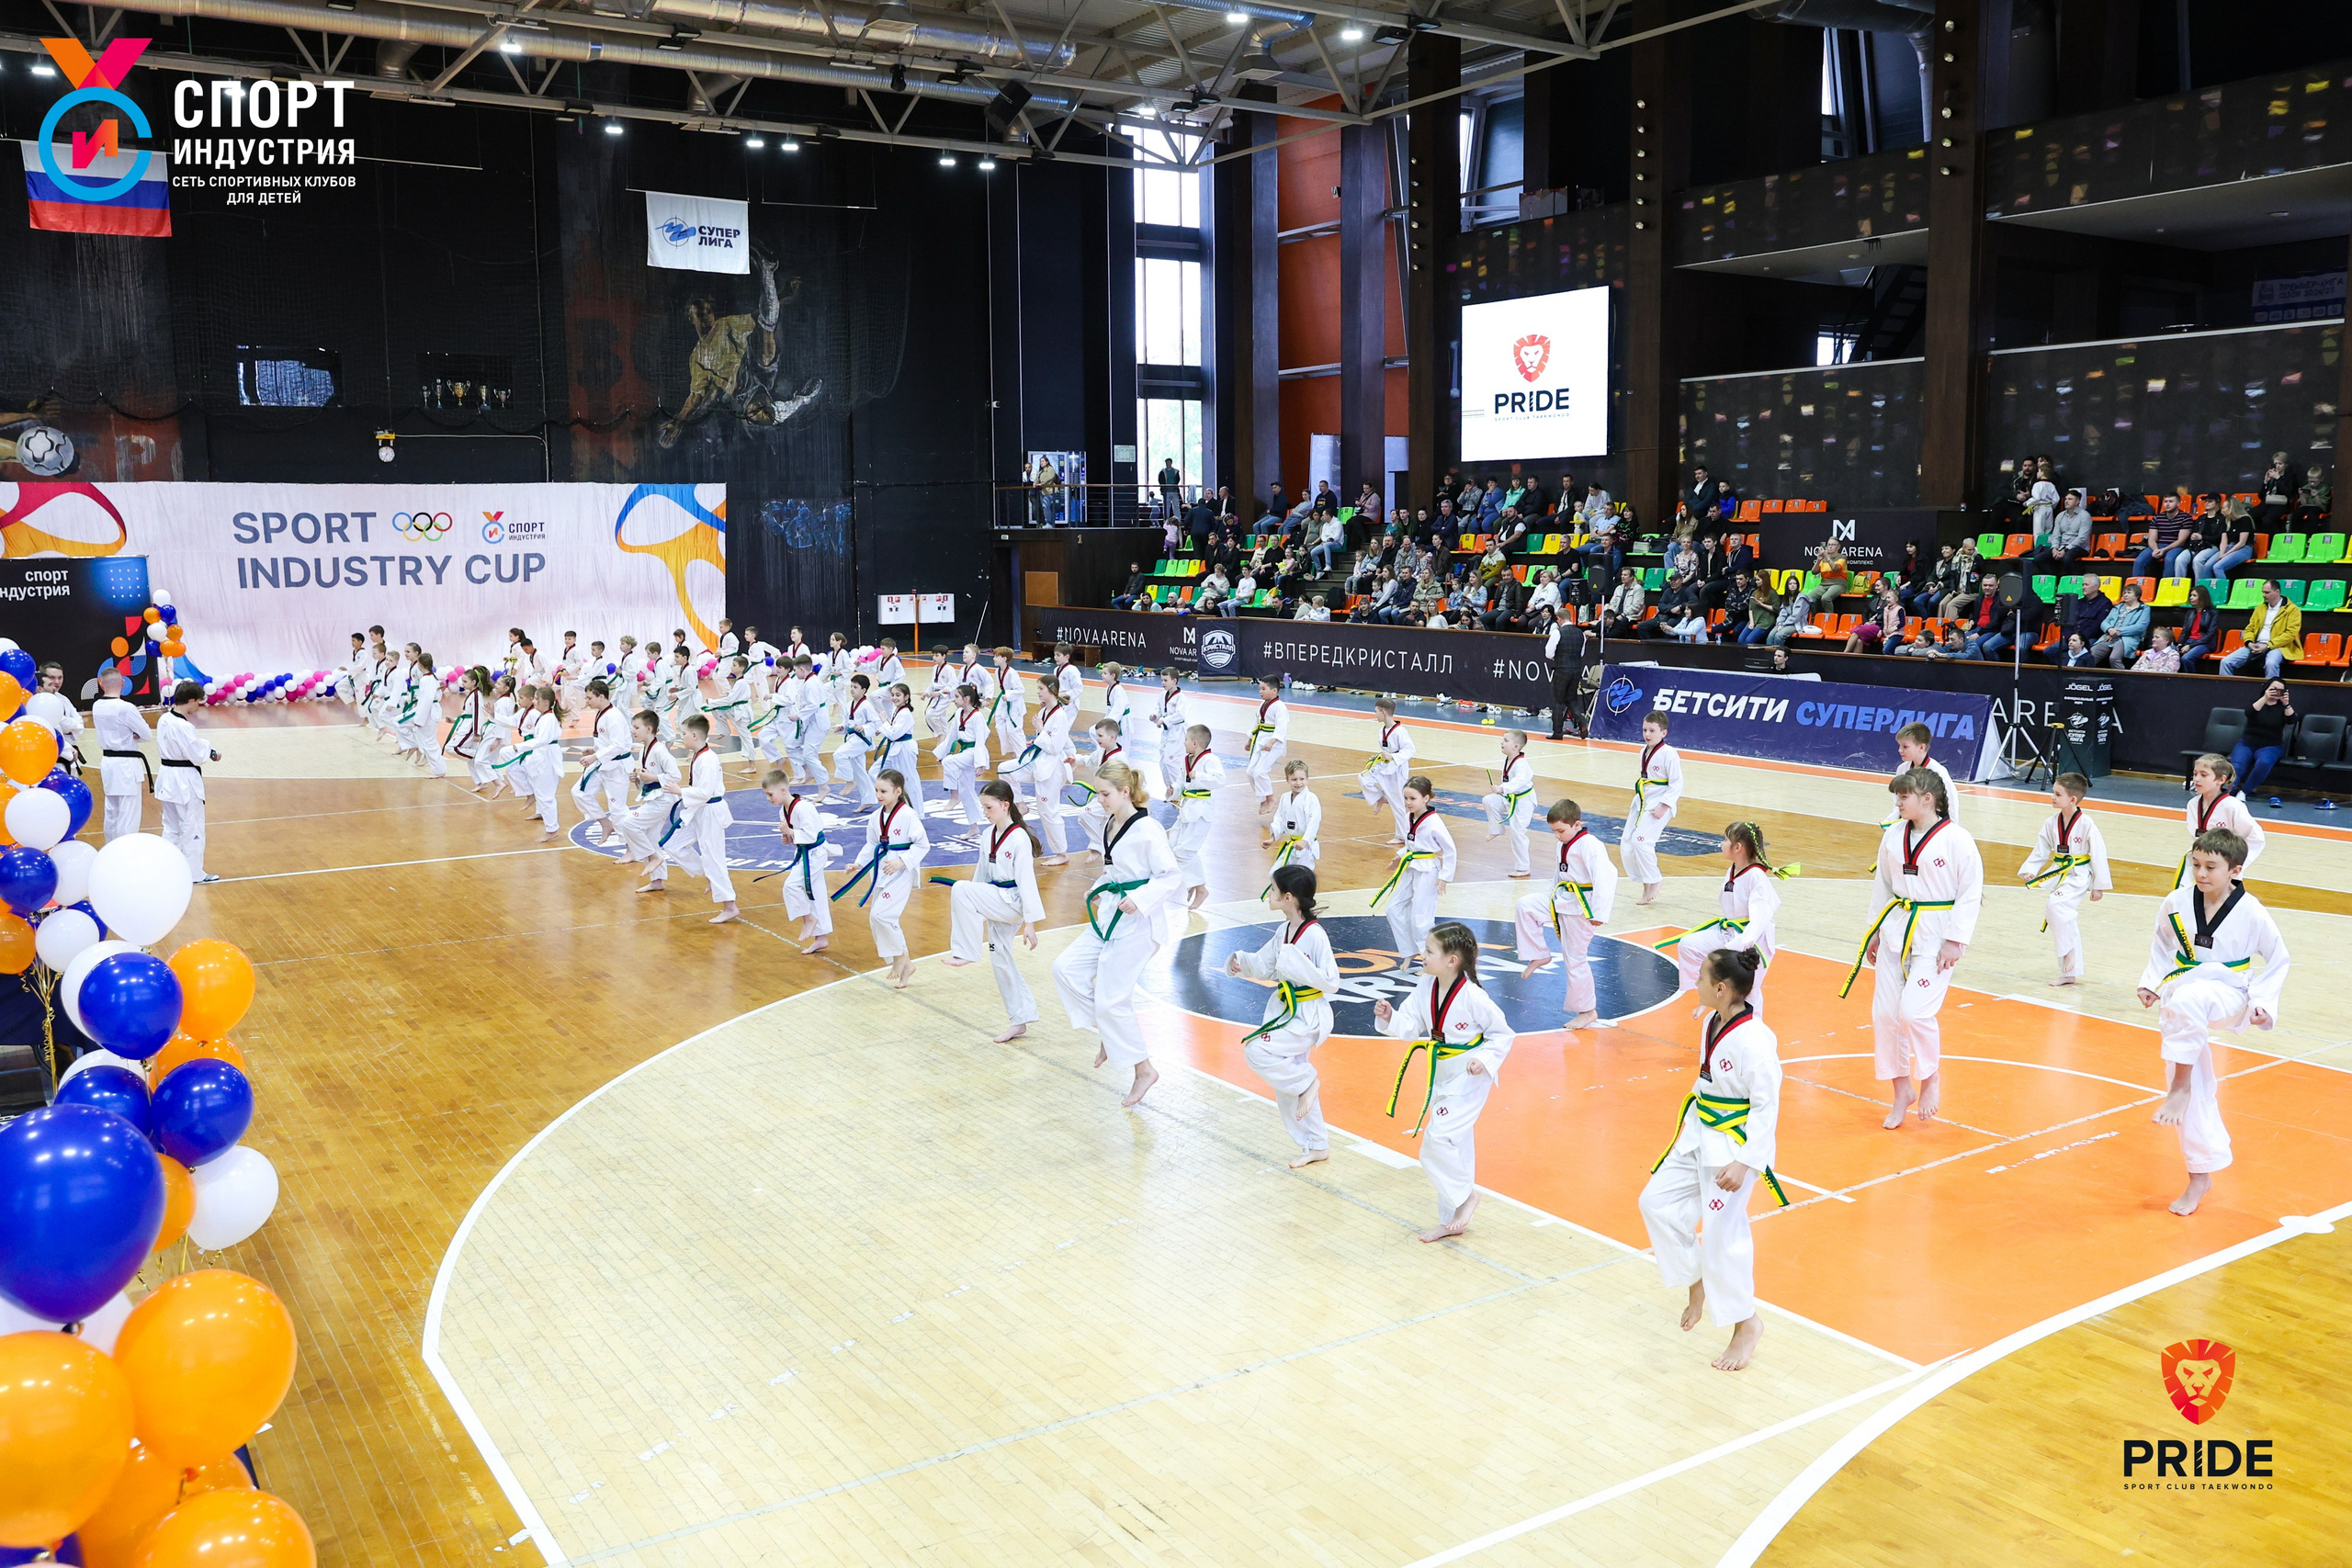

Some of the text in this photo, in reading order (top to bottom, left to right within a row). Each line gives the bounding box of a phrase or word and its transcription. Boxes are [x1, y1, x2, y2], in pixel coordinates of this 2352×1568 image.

[698, 225, 741, 239] СУПЕР
[698, 236, 733, 248] ЛИГА
[1494, 388, 1569, 414] PRIDE
[232, 512, 377, 544] SPORT
[508, 522, 545, 534] СПОРТ
[1077, 534, 1083, 544] 1
[1840, 547, 1883, 557] ARENA
[25, 570, 69, 584] спорт
[237, 552, 546, 589] INDUSTRY CUP
[0, 585, 71, 601] ндустрия
[1057, 626, 1147, 649] #NOVAARENA
[1169, 646, 1187, 655] NOVA
[1263, 641, 1453, 674] #ВПЕРЕДКРИСТАЛЛ
[1653, 688, 1974, 740] БЕТСИТИ СУПЕРЛИГА
